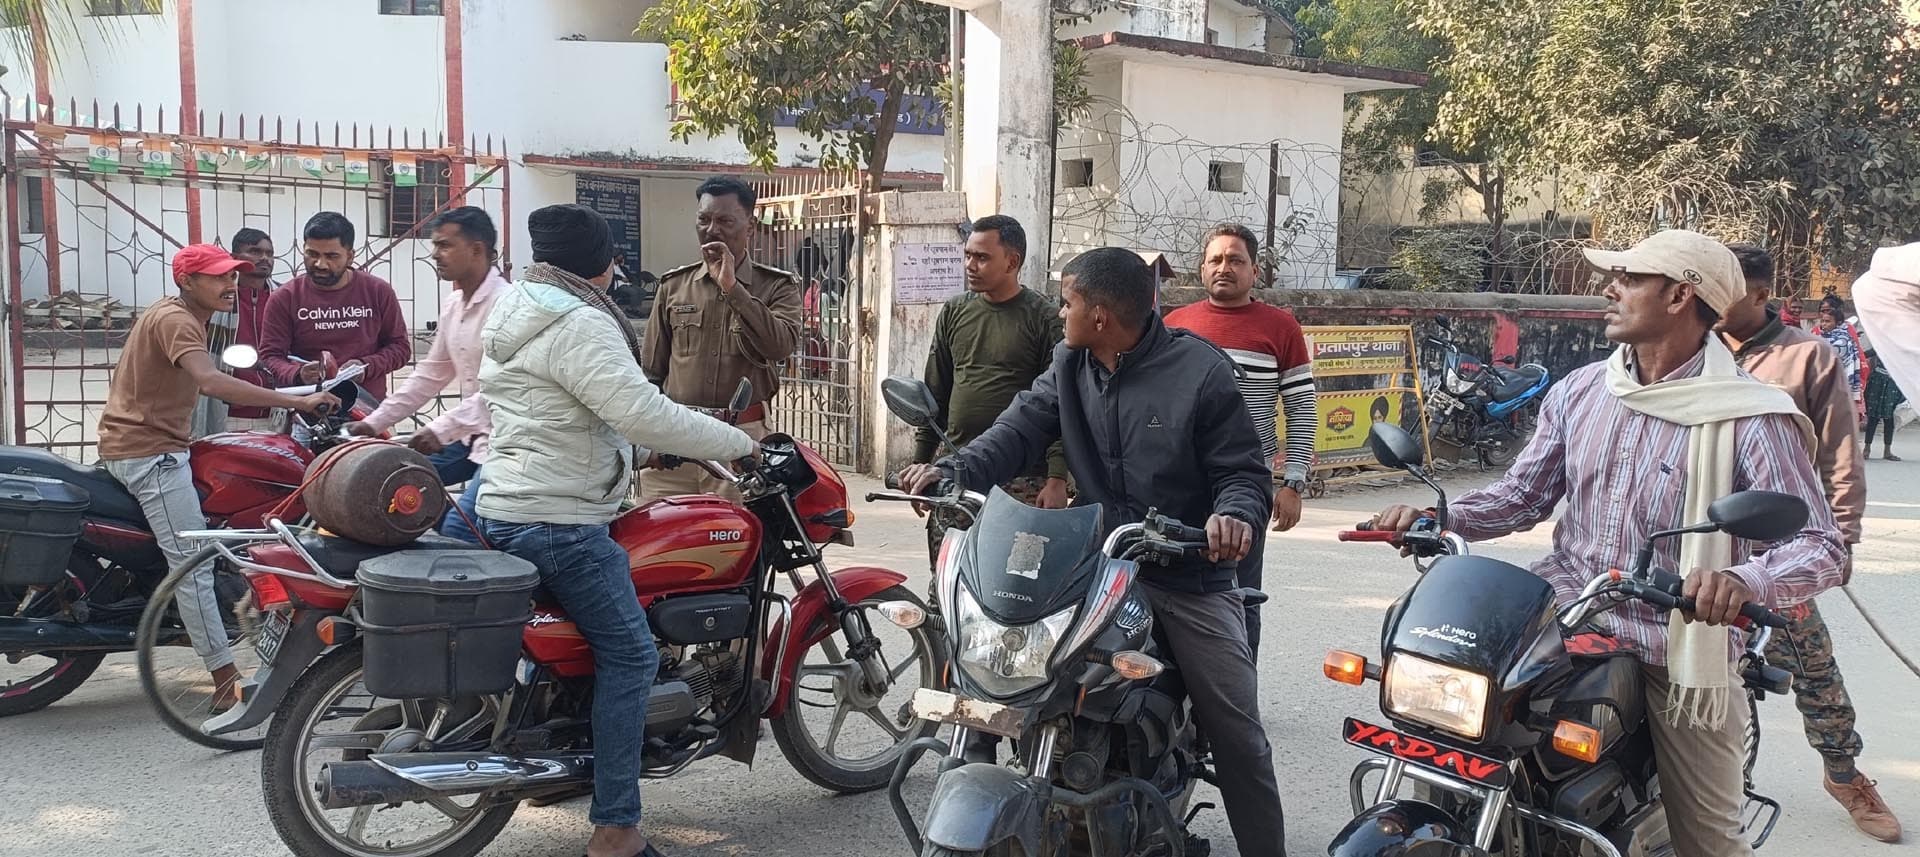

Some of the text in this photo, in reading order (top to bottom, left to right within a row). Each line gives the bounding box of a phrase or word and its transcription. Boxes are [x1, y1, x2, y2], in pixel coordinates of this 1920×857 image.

[297, 306, 373, 320] Calvin Klein
[315, 320, 360, 330] NEW YORK
[1317, 341, 1400, 357] प्रतापपुर थाना
[709, 530, 741, 541] Hero
[992, 590, 1033, 602] HONDA
[1451, 627, 1477, 640] Hero
[1350, 720, 1502, 778] YADAV
